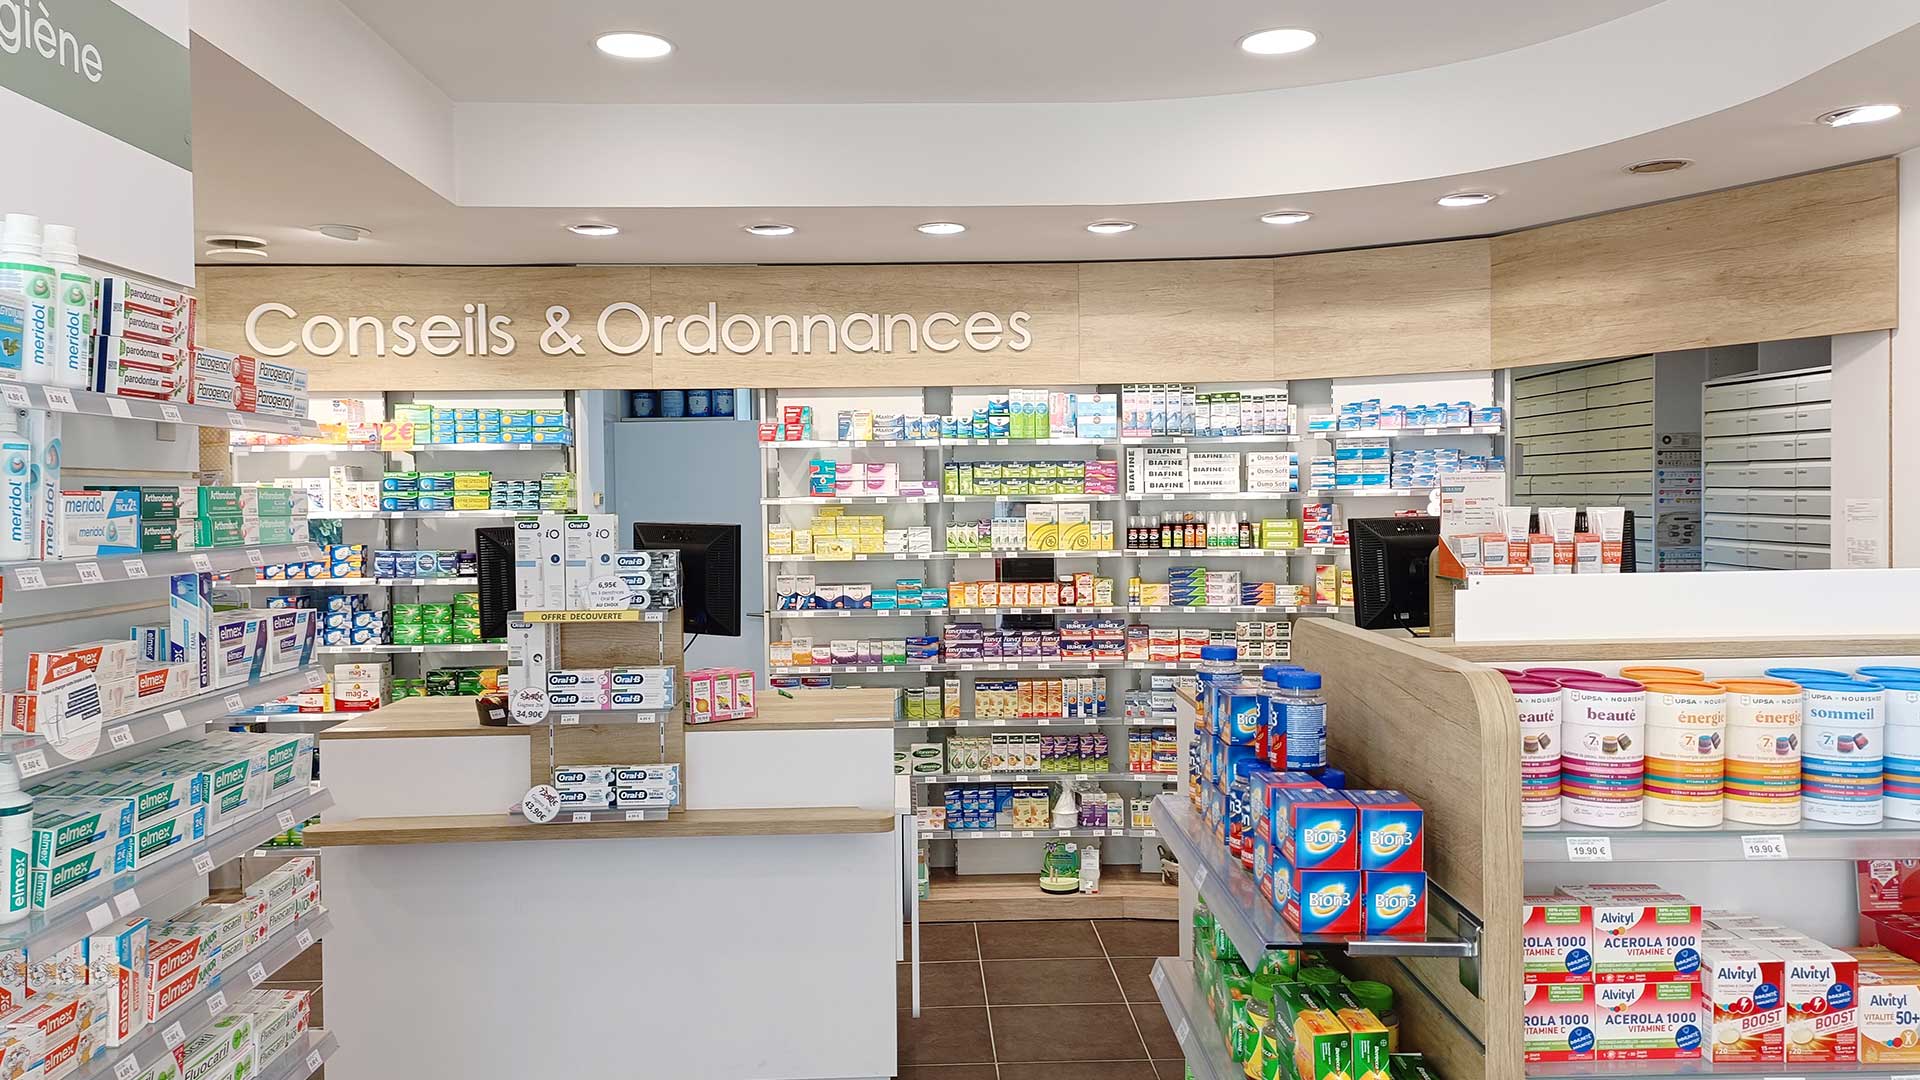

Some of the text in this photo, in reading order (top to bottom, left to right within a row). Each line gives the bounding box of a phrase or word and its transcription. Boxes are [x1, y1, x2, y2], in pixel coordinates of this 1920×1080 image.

[130, 288, 161, 304] parodontax
[128, 316, 159, 331] parodontax
[245, 301, 1032, 356] Conseils & Ordonnances
[32, 303, 45, 365] meridol
[66, 311, 80, 369] meridol
[126, 345, 160, 359] parodontax
[124, 373, 159, 386] parodontax
[259, 362, 294, 384] Parogencyl
[257, 389, 294, 410] Parogencyl
[383, 422, 414, 441] 2€
[9, 481, 22, 541] meridol
[65, 497, 104, 513] meridol
[45, 482, 54, 556] meridol
[79, 525, 104, 537] meridol
[545, 528, 560, 539] iO
[595, 528, 610, 539] iO
[619, 558, 644, 566] Oral-B
[274, 616, 294, 629] elmex
[541, 612, 622, 621] OFFRE DECOUVERTE
[220, 626, 243, 640] elmex
[281, 639, 294, 648] elmex
[227, 651, 244, 661] elmex
[139, 673, 165, 689] elmex
[551, 675, 577, 684] Oral-B
[614, 675, 641, 683] Oral-B
[551, 695, 577, 703] Oral-B
[614, 695, 641, 703] Oral-B
[516, 710, 543, 718] 34,90€
[1237, 713, 1257, 725] Bio
[1519, 709, 1554, 722] eauté
[1587, 707, 1636, 721] beauté
[1811, 708, 1874, 720] sommeil
[269, 746, 294, 765] elmex
[216, 766, 244, 787] elmex
[620, 772, 645, 780] Oral-B
[140, 789, 169, 810] elmex
[222, 794, 240, 807] elmex
[620, 791, 645, 799] Oral-B
[525, 800, 547, 821] 43,90€
[59, 821, 94, 845] elmex
[140, 826, 170, 848] elmex
[1304, 829, 1346, 844] Bion3
[1370, 830, 1413, 846] Bion3
[40, 833, 50, 861] elmex
[1574, 847, 1606, 855] 19.90 €
[1750, 845, 1781, 853] 19.90 €
[53, 860, 88, 885] elmex
[12, 857, 25, 906] elmex
[36, 874, 45, 902] elmex
[1309, 891, 1351, 907] Bion3
[1375, 892, 1417, 908] Bion3
[1601, 912, 1634, 925] Alvityl
[1523, 936, 1586, 947] ROLA 1000
[1604, 936, 1695, 948] ACEROLA 1000
[1524, 948, 1555, 956] ITAMINE
[160, 946, 194, 976] elmex
[1718, 965, 1757, 983] Alvityl
[1791, 965, 1830, 982] Alvityl
[161, 974, 194, 1006] elmex
[1602, 988, 1635, 1002] Alvityl
[120, 976, 129, 1033] elmex
[1870, 992, 1907, 1009] Alvityl
[1524, 1014, 1589, 1026] ROLA 1000
[1606, 1012, 1696, 1025] ACEROLA 1000
[1742, 1009, 1782, 1029] BOOST
[1815, 1010, 1856, 1029] BOOST
[1896, 1011, 1920, 1025] 50+
[1560, 1026, 1566, 1034] C
[1628, 1025, 1666, 1033] VITAMINE
[44, 1043, 75, 1071] elmex
[185, 1041, 230, 1080] Fluocaril
